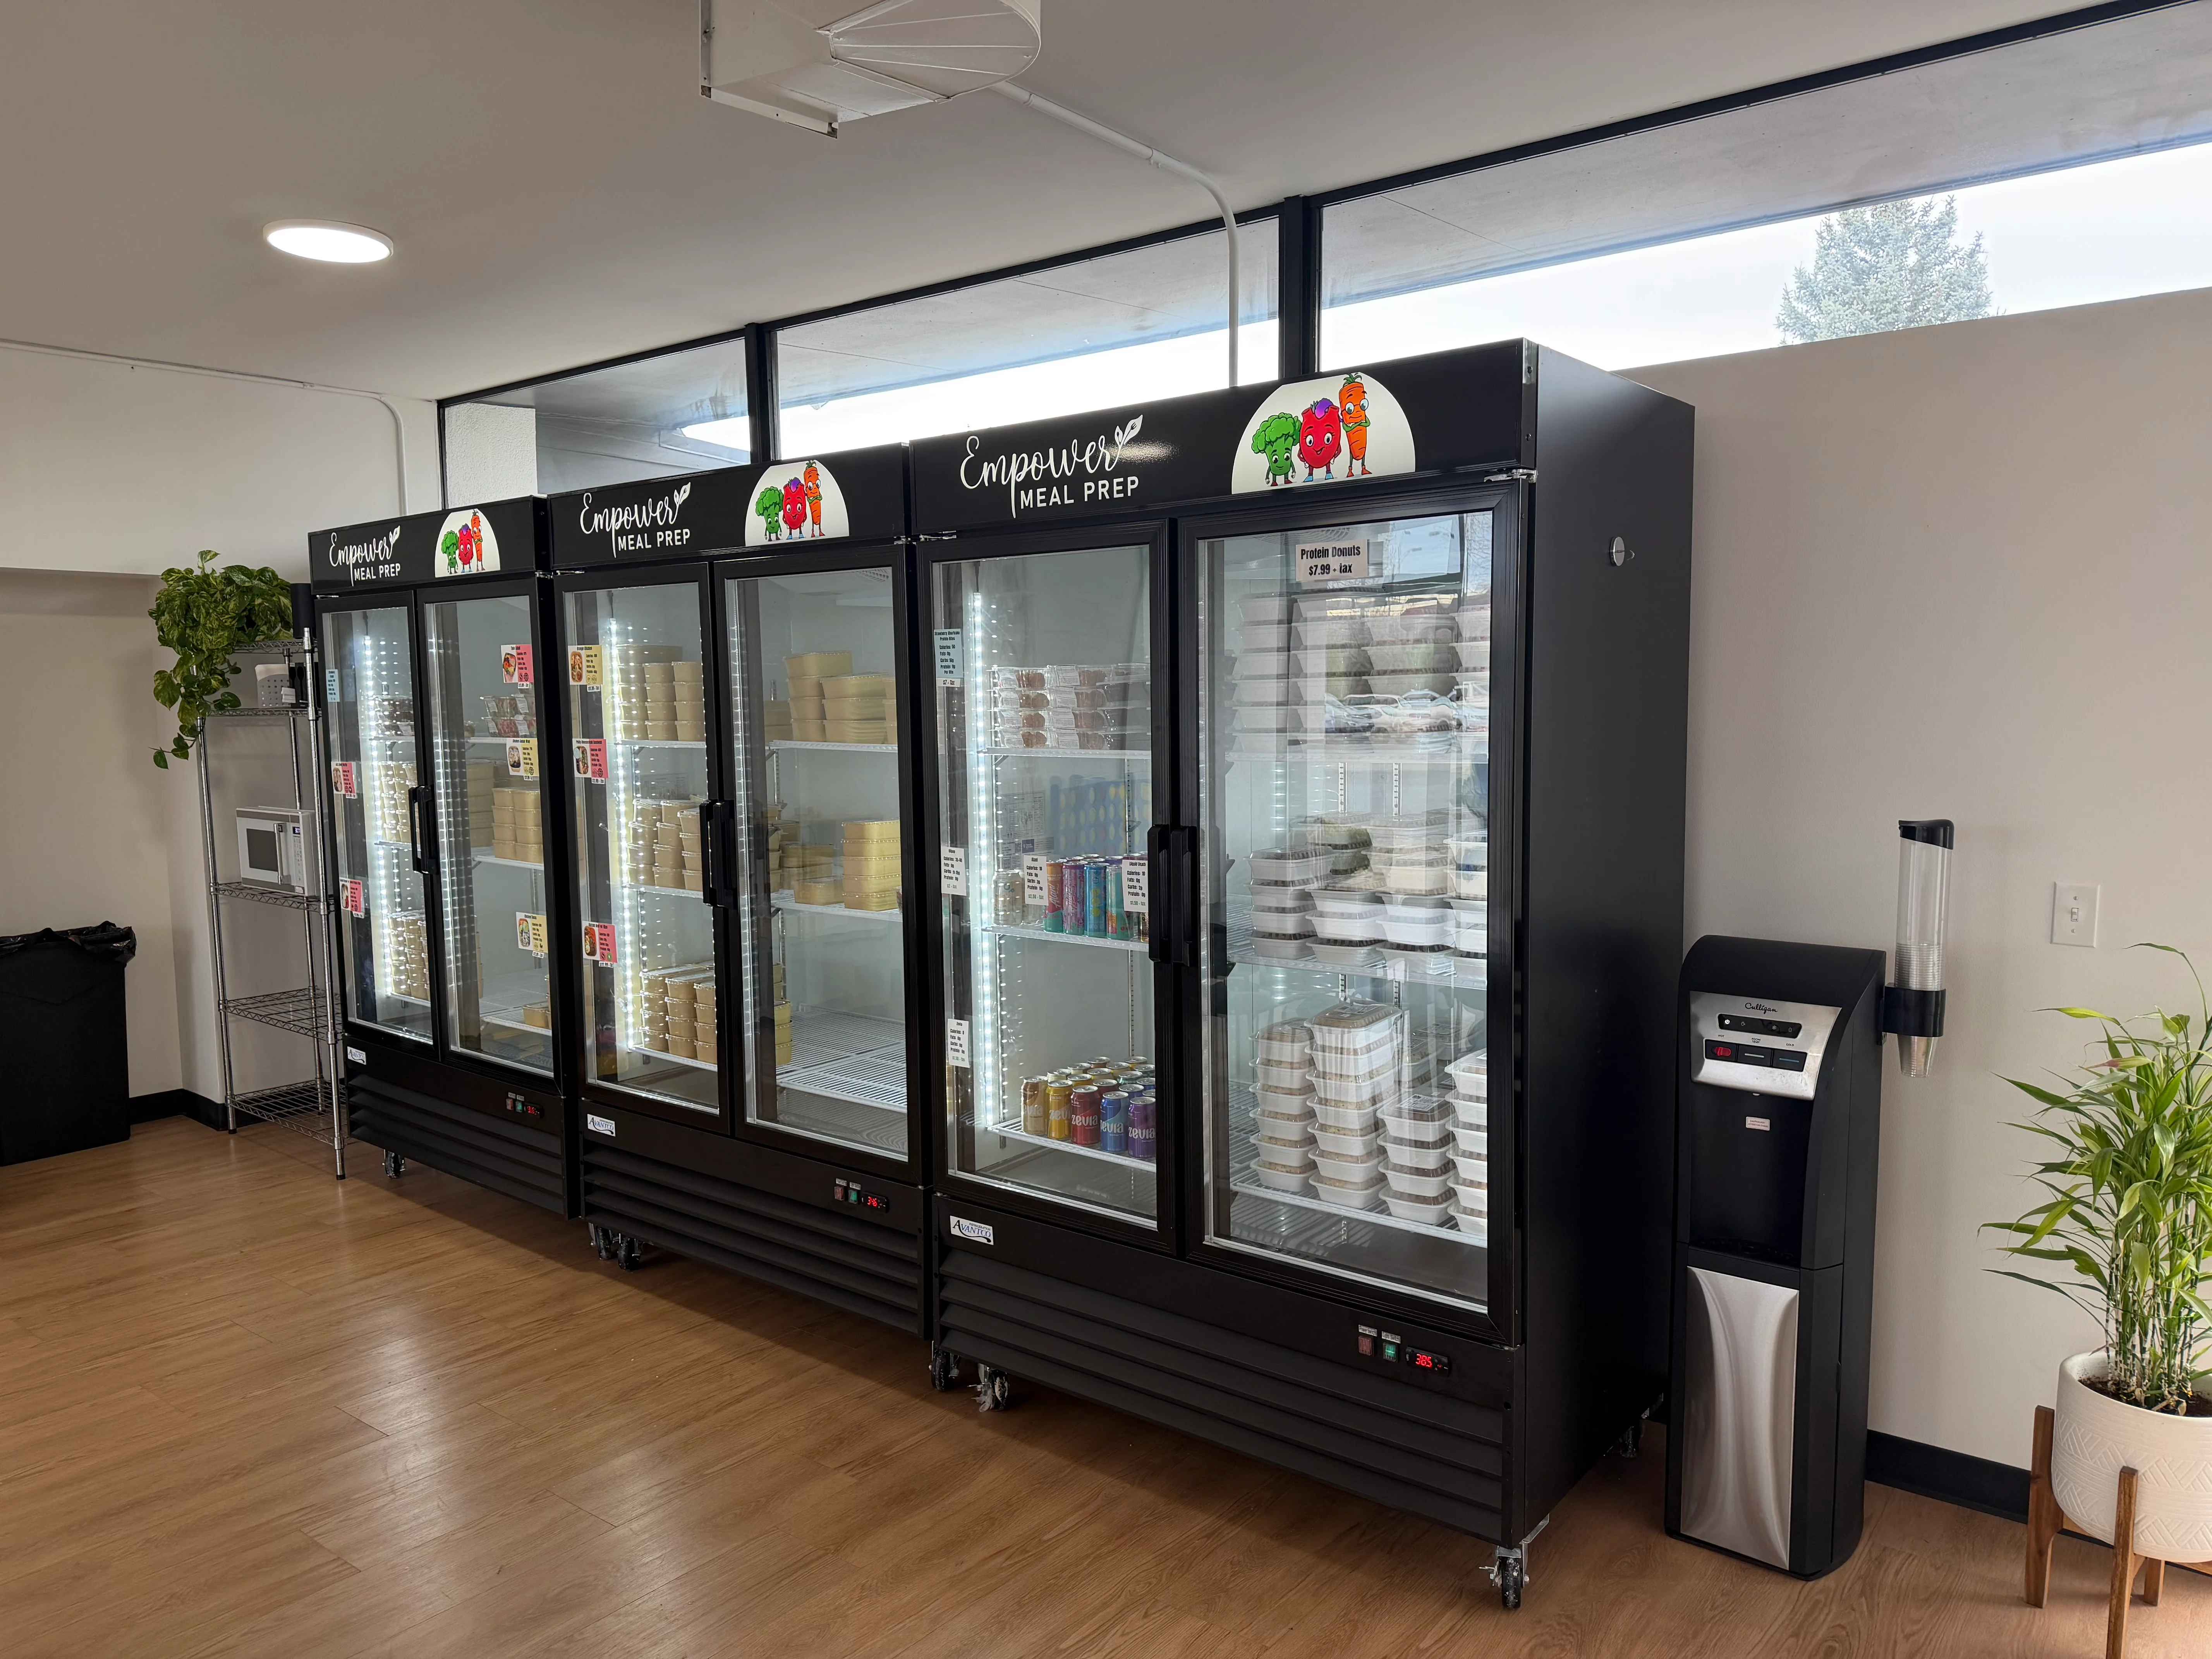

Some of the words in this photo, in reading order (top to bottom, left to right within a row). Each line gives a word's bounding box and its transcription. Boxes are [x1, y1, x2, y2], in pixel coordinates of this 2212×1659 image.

[960, 436, 1122, 519] Empower
[1020, 484, 1074, 509] MEAL
[1084, 476, 1139, 501] PREP
[580, 493, 678, 558] Empower
[618, 532, 652, 551] MEAL
[657, 528, 690, 548] PREP
[329, 532, 395, 586] Empower
[1301, 547, 1329, 560] Protein
[1331, 545, 1361, 558] Donuts
[354, 568, 376, 581] MEAL
[380, 563, 401, 578] PREP
[1309, 563, 1331, 576] $7.99
[1339, 563, 1352, 574] tax
[1745, 1002, 1778, 1014] Culligan
[1072, 1115, 1098, 1126] zevia
[952, 1220, 991, 1243] AVANTCO
